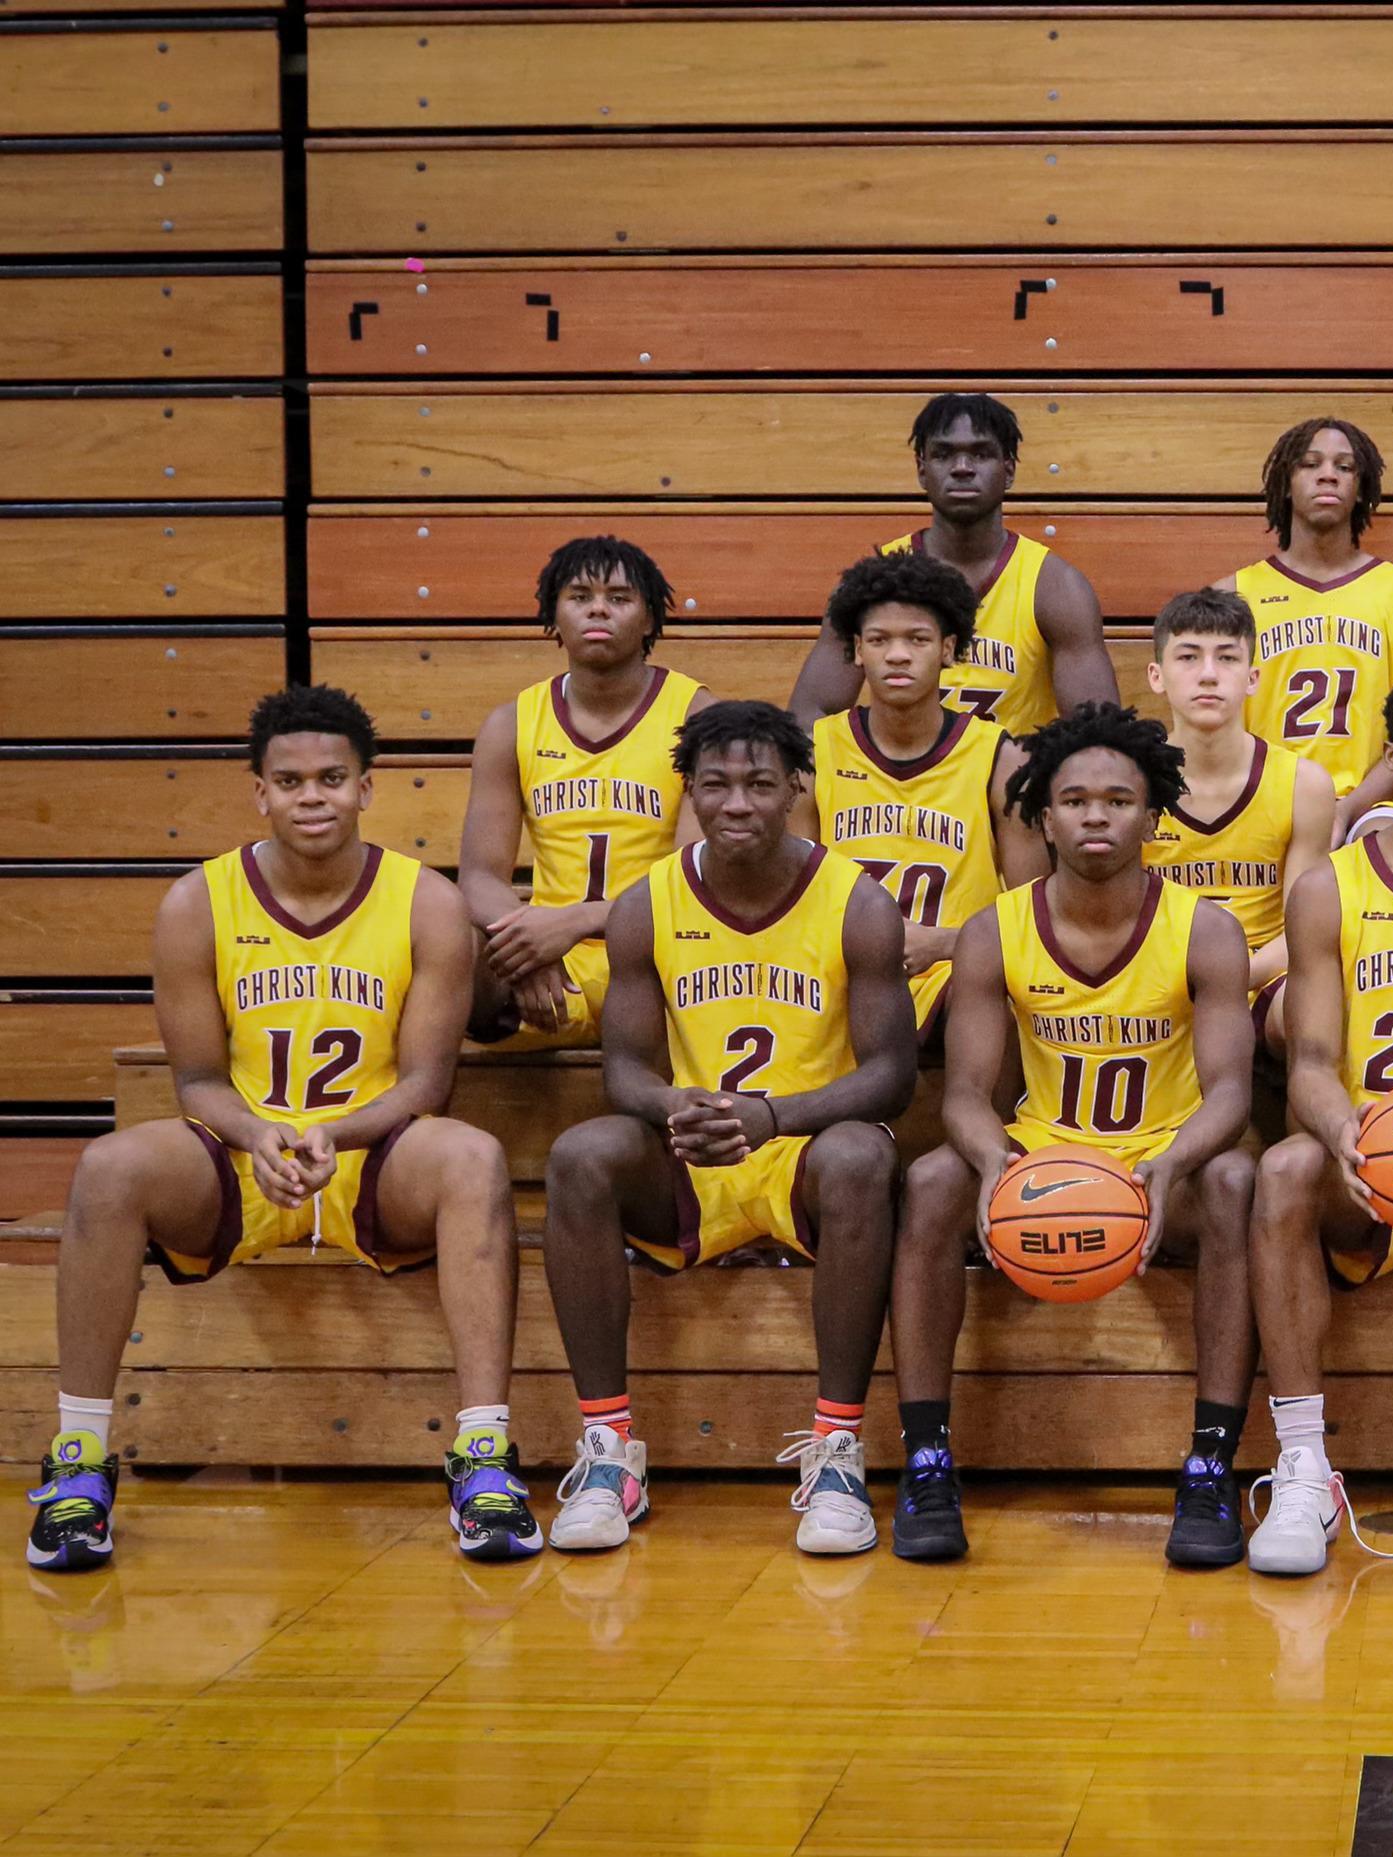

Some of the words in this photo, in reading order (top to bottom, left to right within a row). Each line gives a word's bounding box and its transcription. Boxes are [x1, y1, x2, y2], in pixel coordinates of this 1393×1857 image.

[970, 636, 1016, 675] KING
[1260, 617, 1323, 660] CHRIST
[1337, 619, 1380, 657] KING
[1283, 668, 1355, 740] 21
[533, 779, 598, 817] CHRIST
[613, 780, 661, 819] KING
[835, 804, 905, 842] CHRIST
[917, 809, 964, 852] KING
[583, 834, 608, 903] 1
[1232, 861, 1278, 886] KING
[237, 965, 316, 1011] CHRIST
[331, 966, 384, 1011] KING
[677, 962, 755, 1008] CHRIST
[768, 965, 821, 1012] KING
[1032, 1013, 1102, 1045] CHRIST
[1119, 1016, 1172, 1044] KING
[263, 1029, 362, 1110] 12
[720, 1026, 774, 1099] 2
[1054, 1054, 1148, 1133] 10
[1019, 1229, 1106, 1255] ELITE
